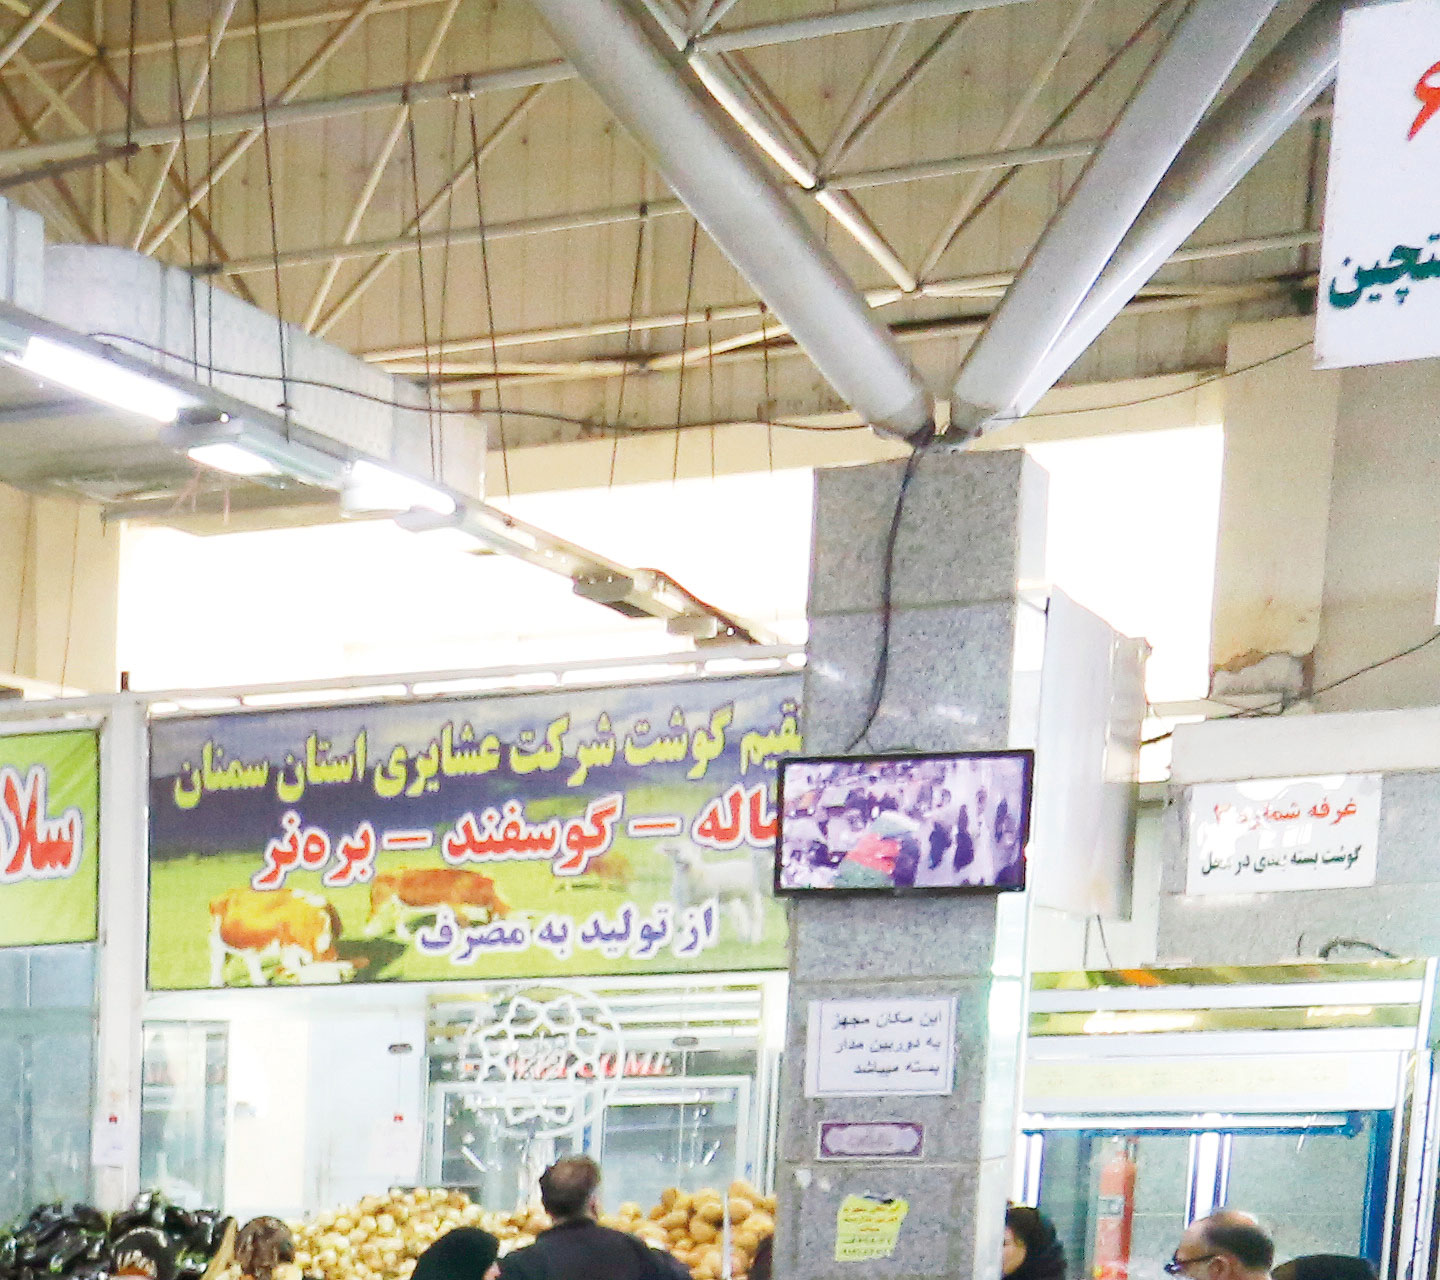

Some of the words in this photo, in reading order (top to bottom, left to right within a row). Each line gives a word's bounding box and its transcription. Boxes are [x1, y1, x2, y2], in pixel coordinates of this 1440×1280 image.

[1329, 233, 1440, 310] تچین
[276, 728, 368, 802] استان
[374, 722, 500, 799] عشایری
[511, 713, 616, 786] شرکت
[624, 703, 734, 779] گوشت
[172, 737, 268, 809] سمنان
[443, 789, 623, 875] گوسفند
[693, 783, 781, 848] اله
[1307, 796, 1358, 826] غرفه
[1321, 845, 1361, 871] گوشت
[420, 912, 525, 964] مصرف
[539, 921, 568, 959] به
[581, 908, 671, 956] تولید
[679, 900, 718, 951] از
[876, 1010, 912, 1029] مکان
[920, 1008, 941, 1028] این
